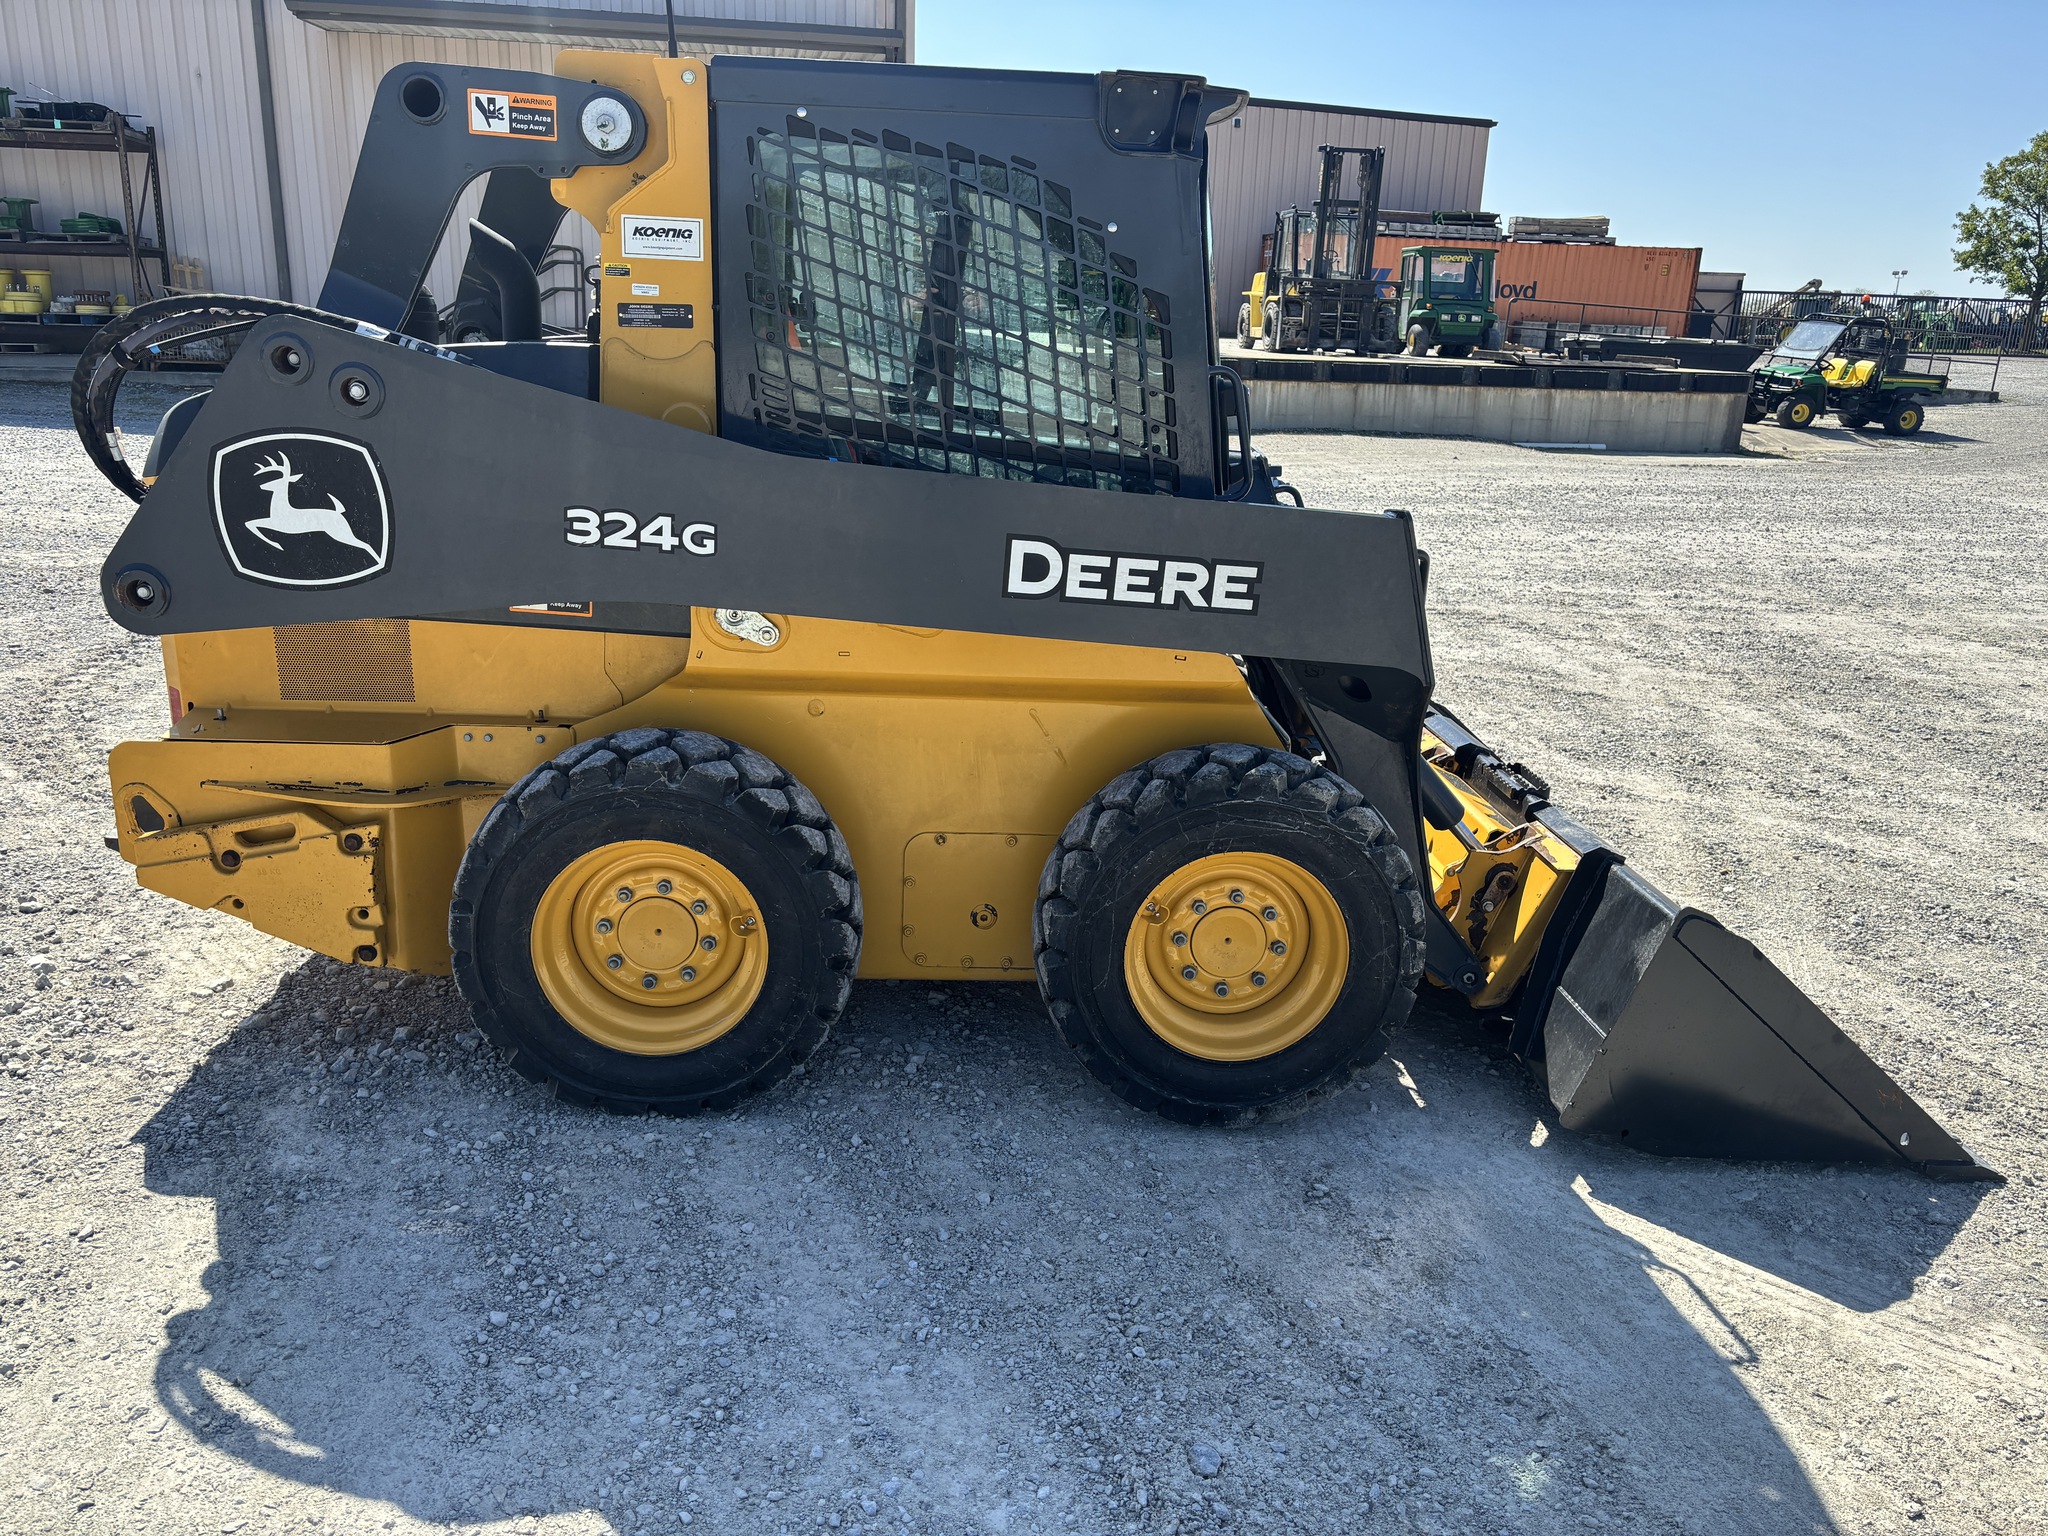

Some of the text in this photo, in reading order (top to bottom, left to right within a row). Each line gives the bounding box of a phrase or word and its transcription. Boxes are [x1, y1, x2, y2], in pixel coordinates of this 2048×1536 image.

[519, 97, 553, 106] WARNING
[512, 112, 551, 122] Pinch Area
[512, 122, 546, 132] Keep Away
[566, 507, 716, 556] 324G
[1006, 538, 1260, 611] DEERE
